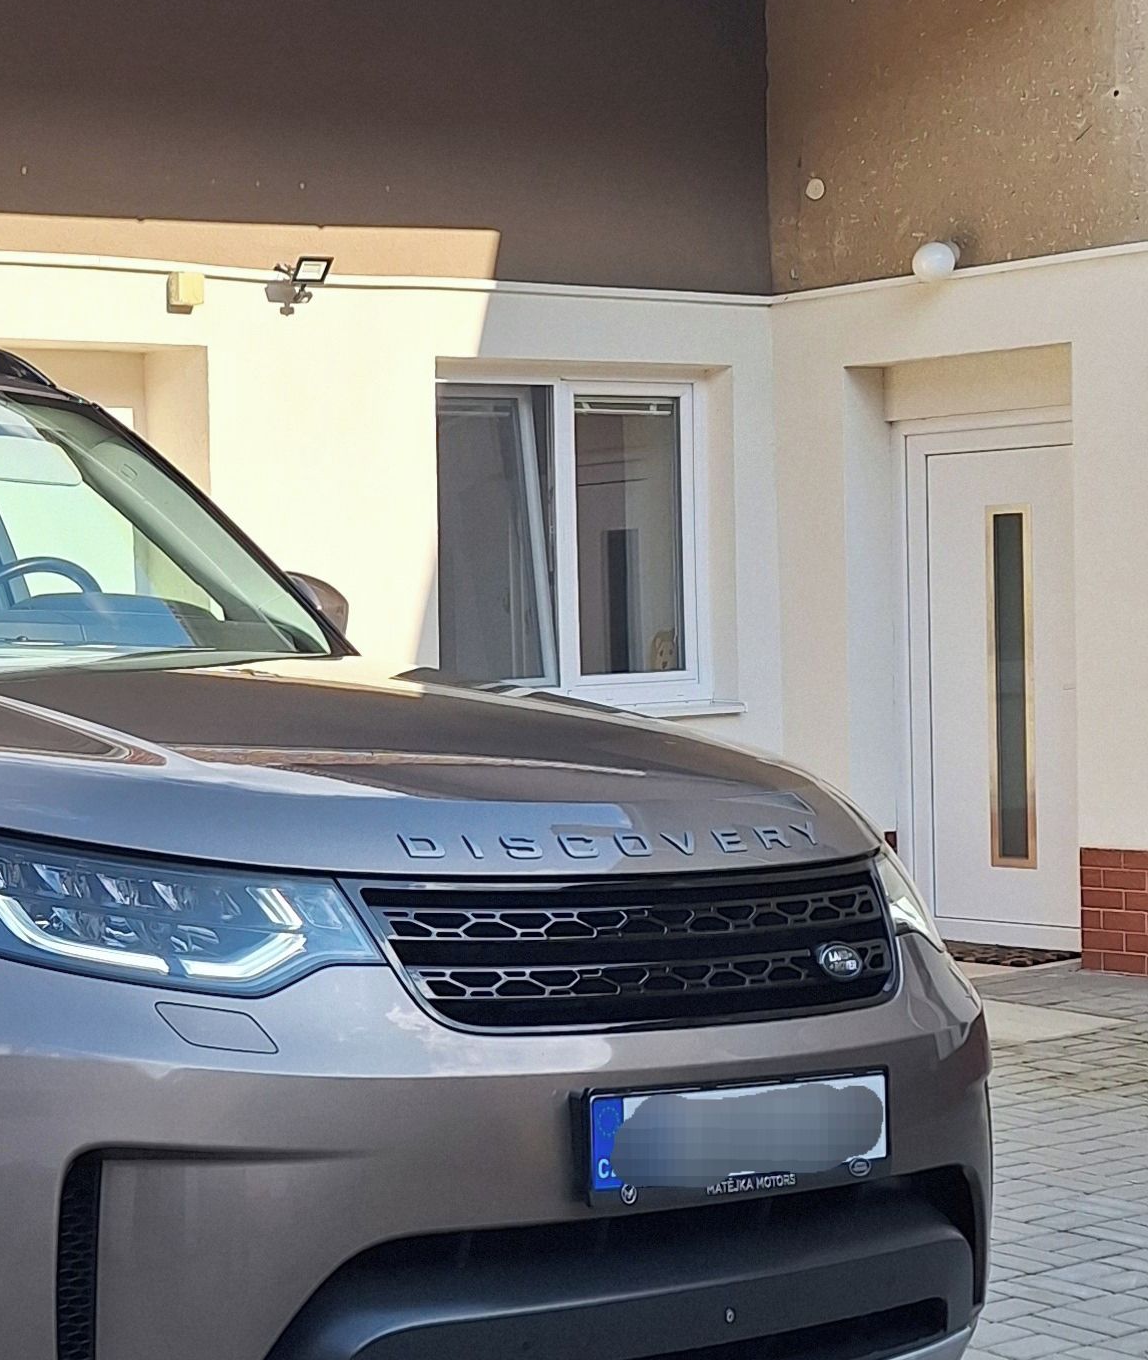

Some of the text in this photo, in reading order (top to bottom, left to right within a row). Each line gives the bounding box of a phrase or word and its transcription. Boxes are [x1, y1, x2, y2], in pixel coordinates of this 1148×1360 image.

[396, 820, 818, 860] DISCOVERY
[598, 1158, 617, 1179] C
[756, 1173, 796, 1190] MOTORS
